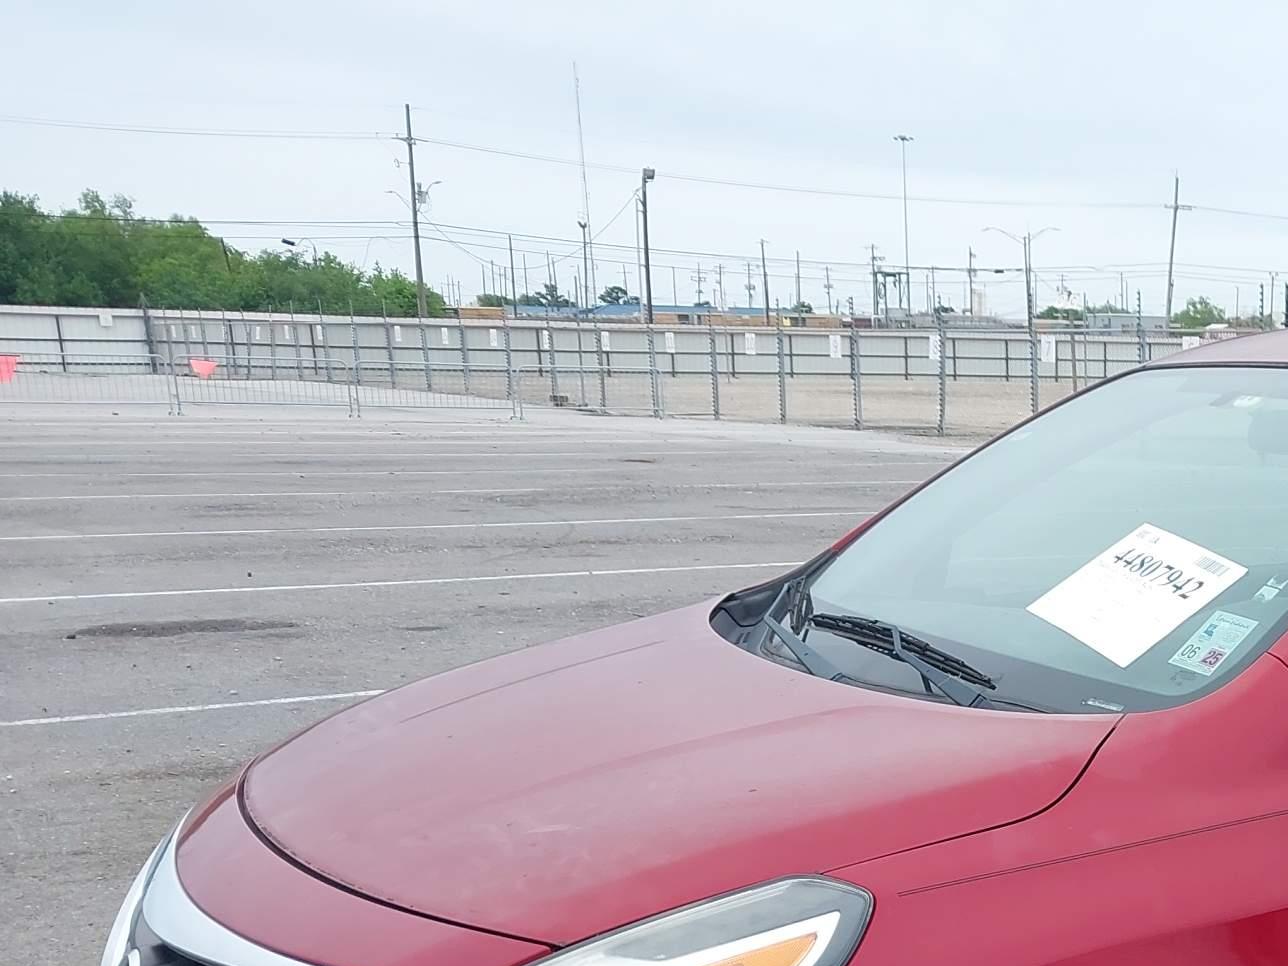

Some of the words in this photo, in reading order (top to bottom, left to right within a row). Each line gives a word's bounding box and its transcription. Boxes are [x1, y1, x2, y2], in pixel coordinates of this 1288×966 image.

[1113, 547, 1205, 600] 44807942
[1181, 644, 1201, 659] 06
[1200, 652, 1223, 666] 25
